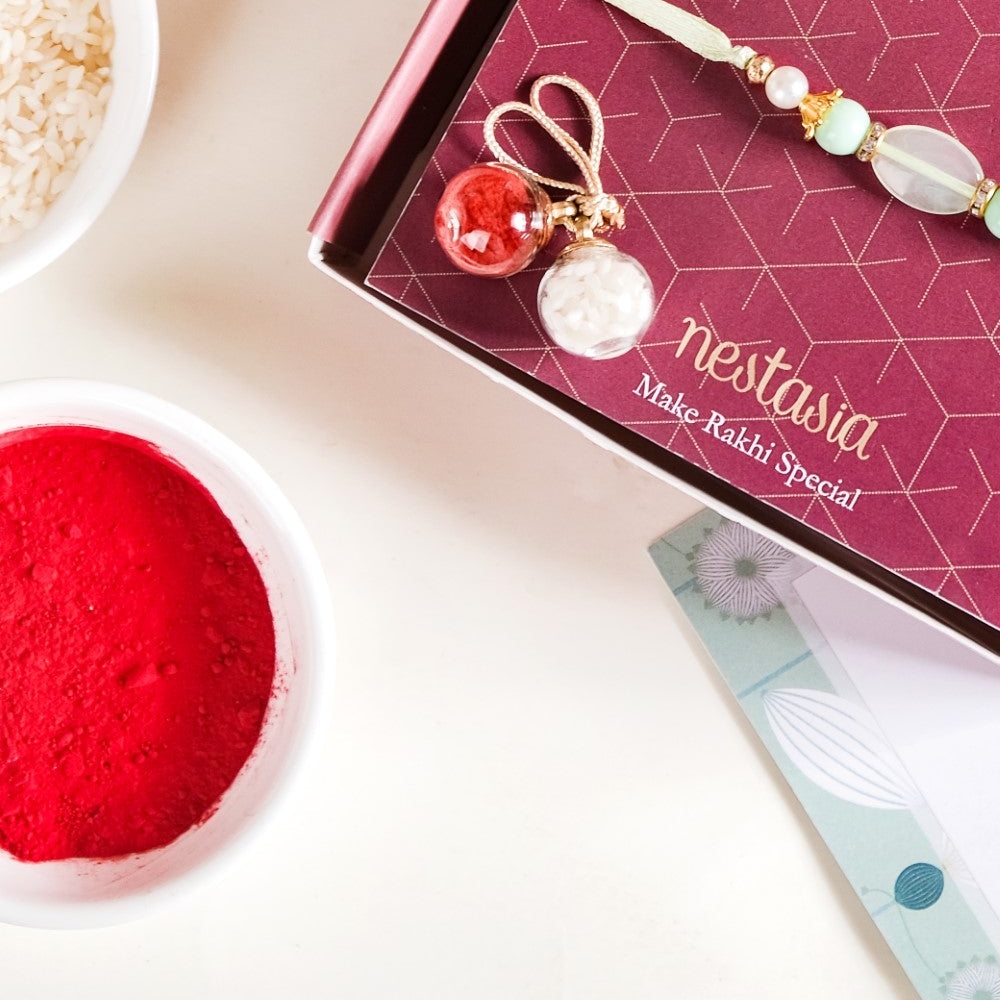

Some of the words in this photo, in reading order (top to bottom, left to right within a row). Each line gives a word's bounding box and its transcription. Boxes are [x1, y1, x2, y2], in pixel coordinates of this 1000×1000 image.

[632, 373, 700, 424] Make
[702, 410, 776, 464] Rakhi
[775, 451, 861, 511] Special
[675, 317, 878, 460] nestasia
